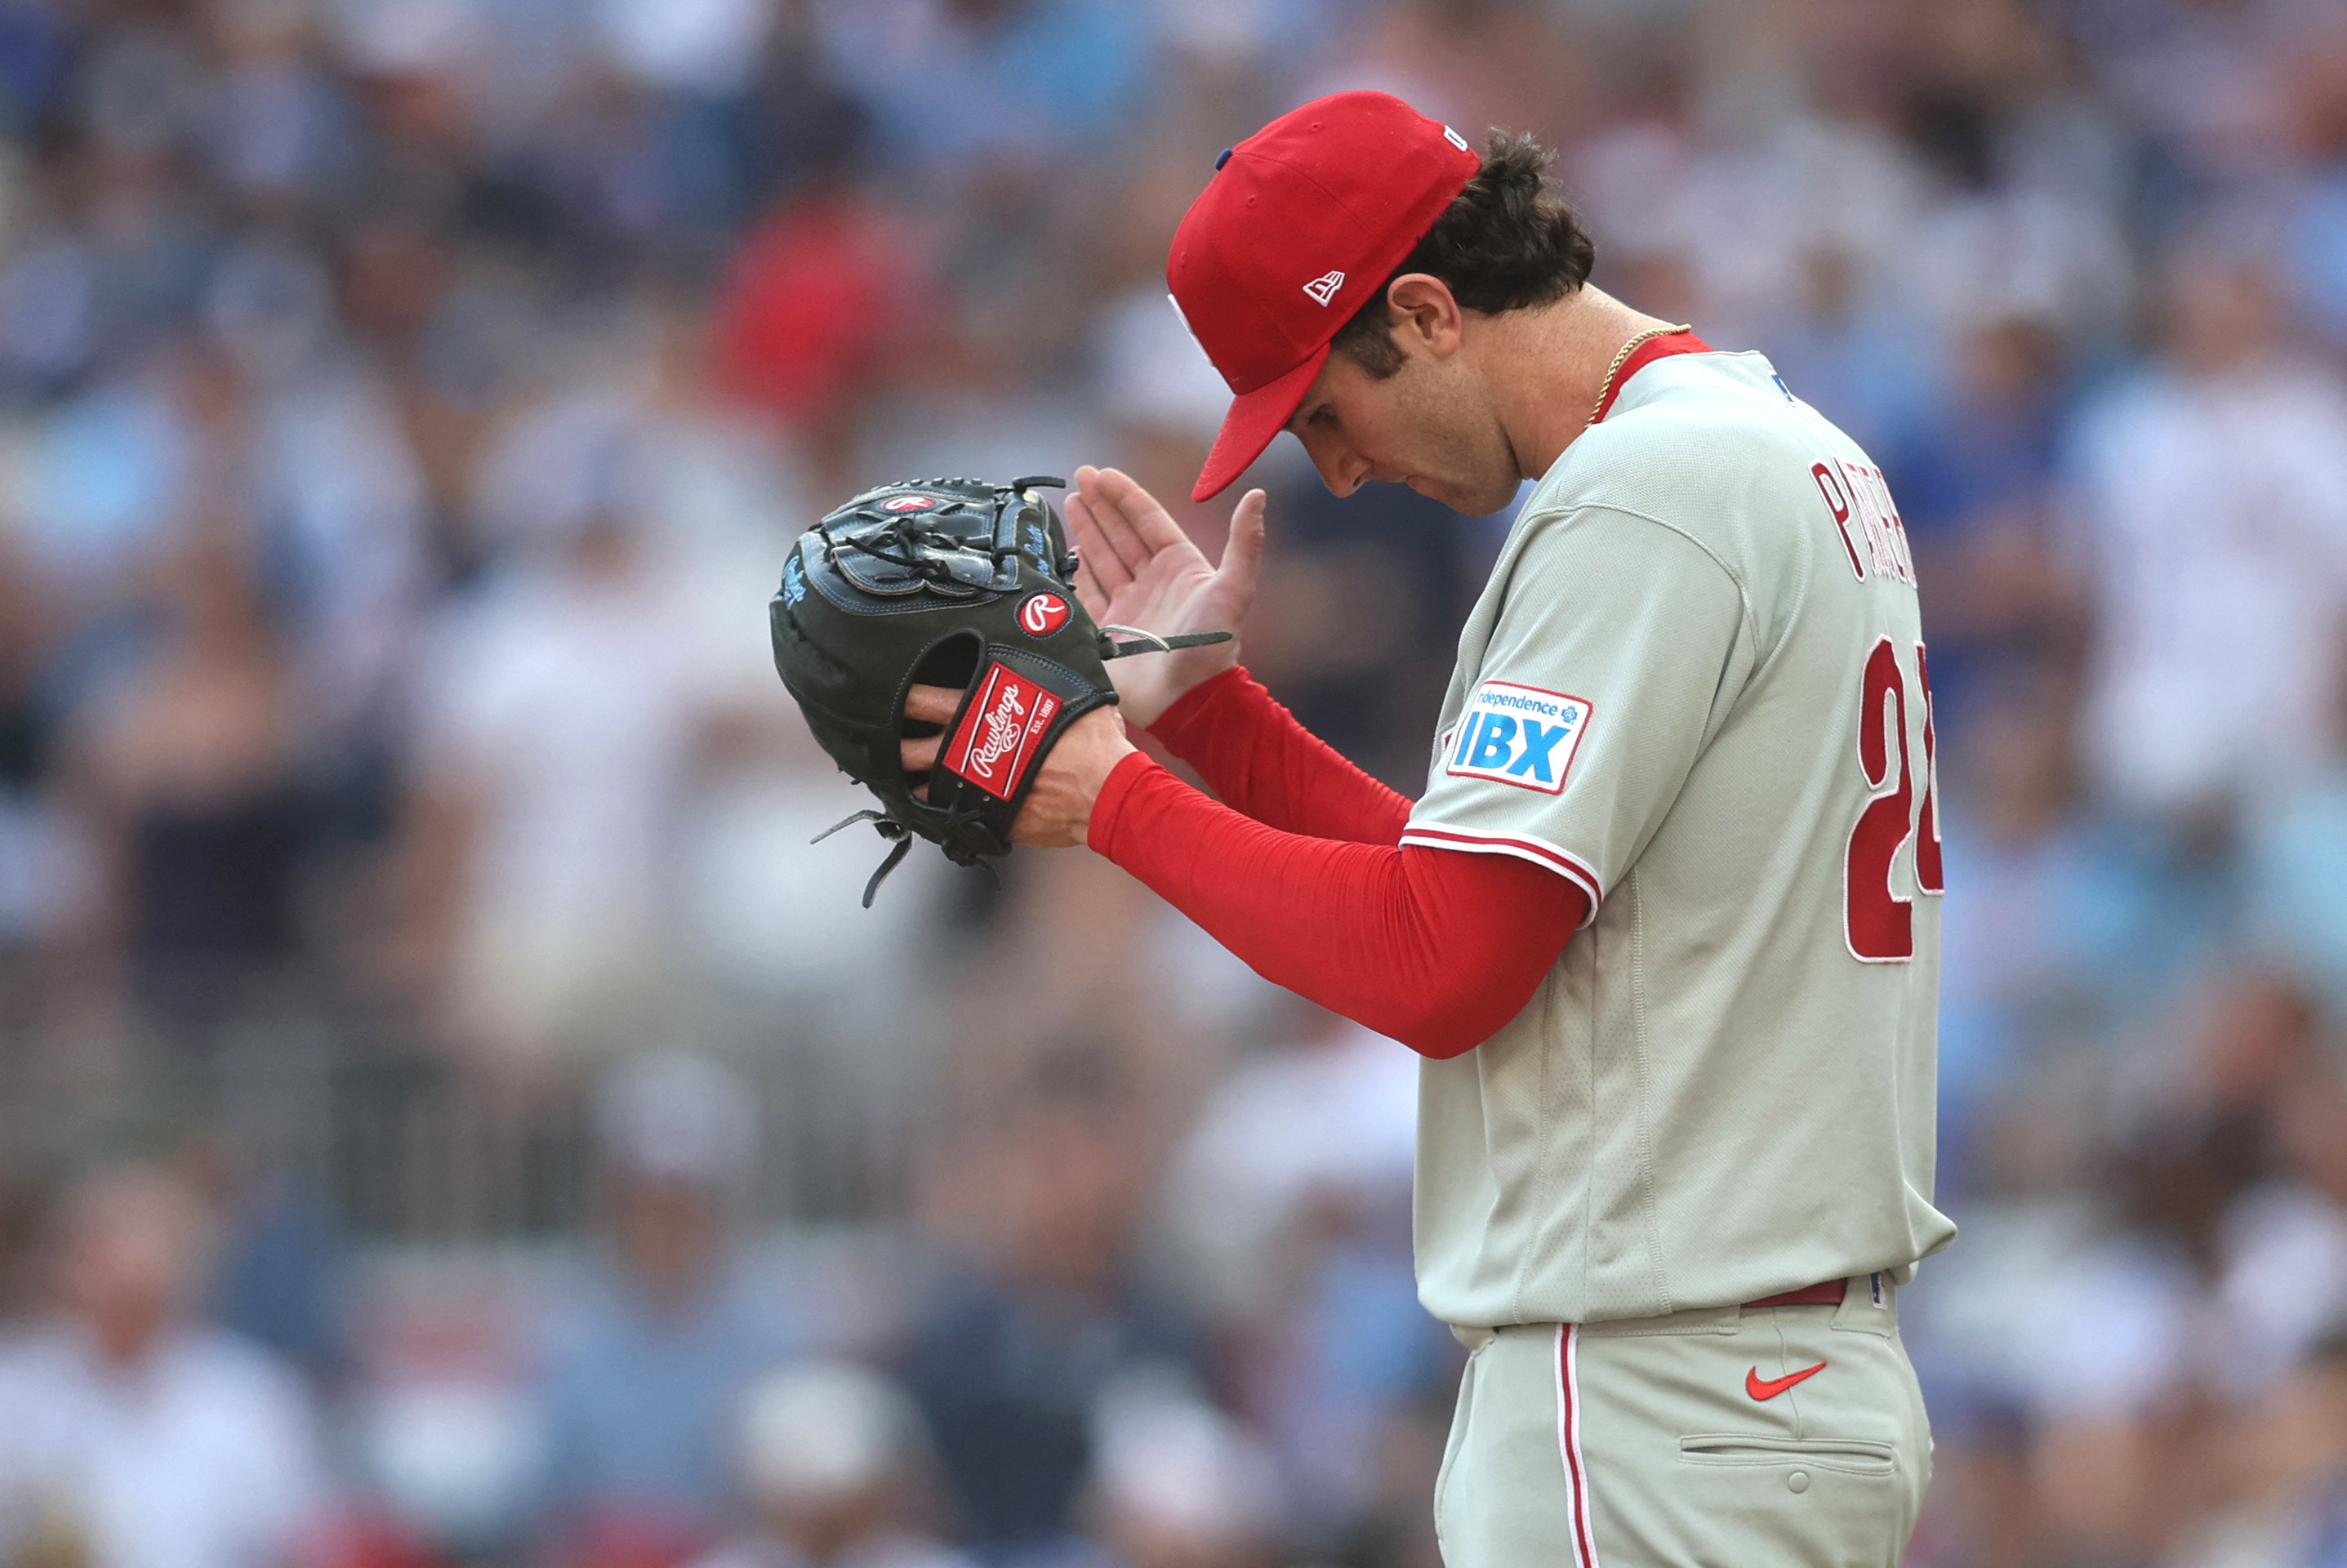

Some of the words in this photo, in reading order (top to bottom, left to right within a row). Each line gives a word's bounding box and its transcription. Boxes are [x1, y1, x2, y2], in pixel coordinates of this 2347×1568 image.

[885, 497, 929, 510] R
[1025, 595, 1065, 631] R
[970, 684, 1025, 777] Rawlings
[1030, 719, 1045, 735] Est.
[1039, 698, 1055, 718] 1887
[1454, 711, 1570, 783] IBX
[1843, 634, 1945, 964] 2
